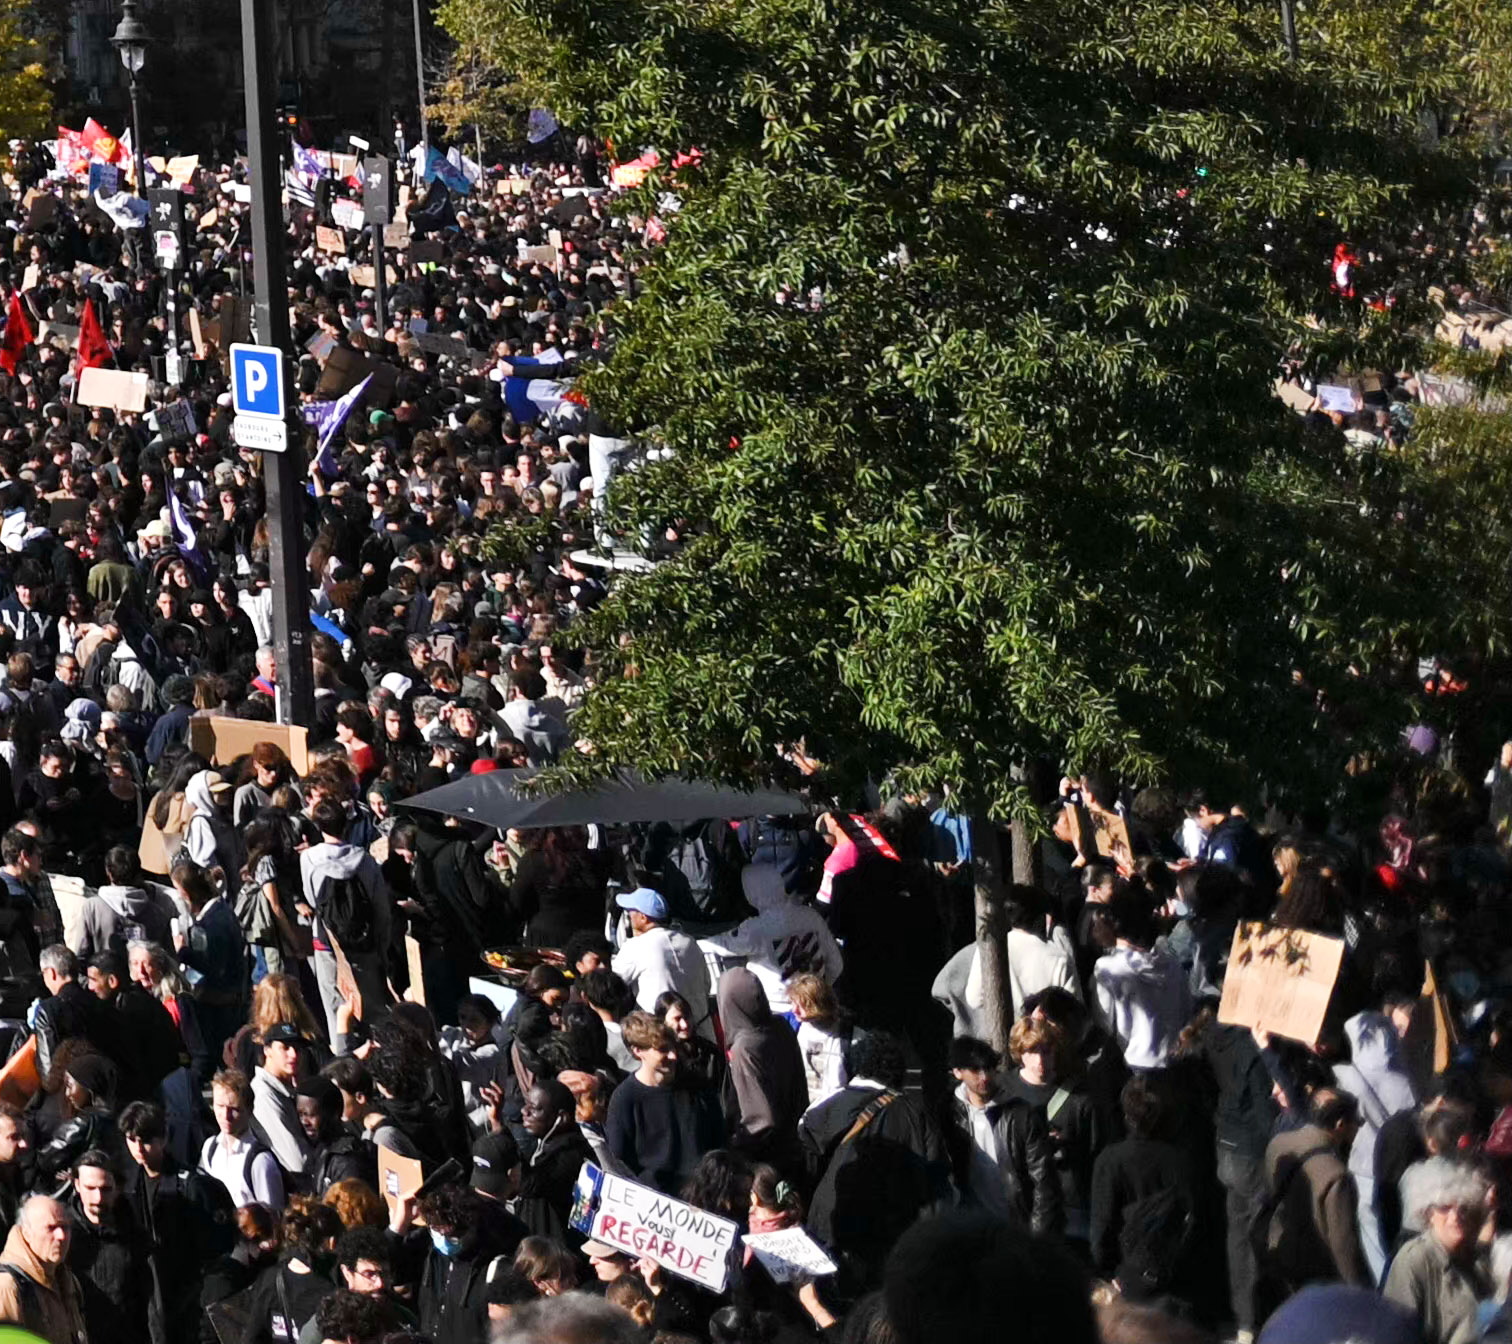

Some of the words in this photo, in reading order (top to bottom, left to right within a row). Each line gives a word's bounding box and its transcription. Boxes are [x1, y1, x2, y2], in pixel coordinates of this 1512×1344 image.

[244, 359, 268, 403] P
[607, 1177, 637, 1207] LE
[648, 1197, 733, 1247] MONDE
[599, 1214, 716, 1281] REGARDE
